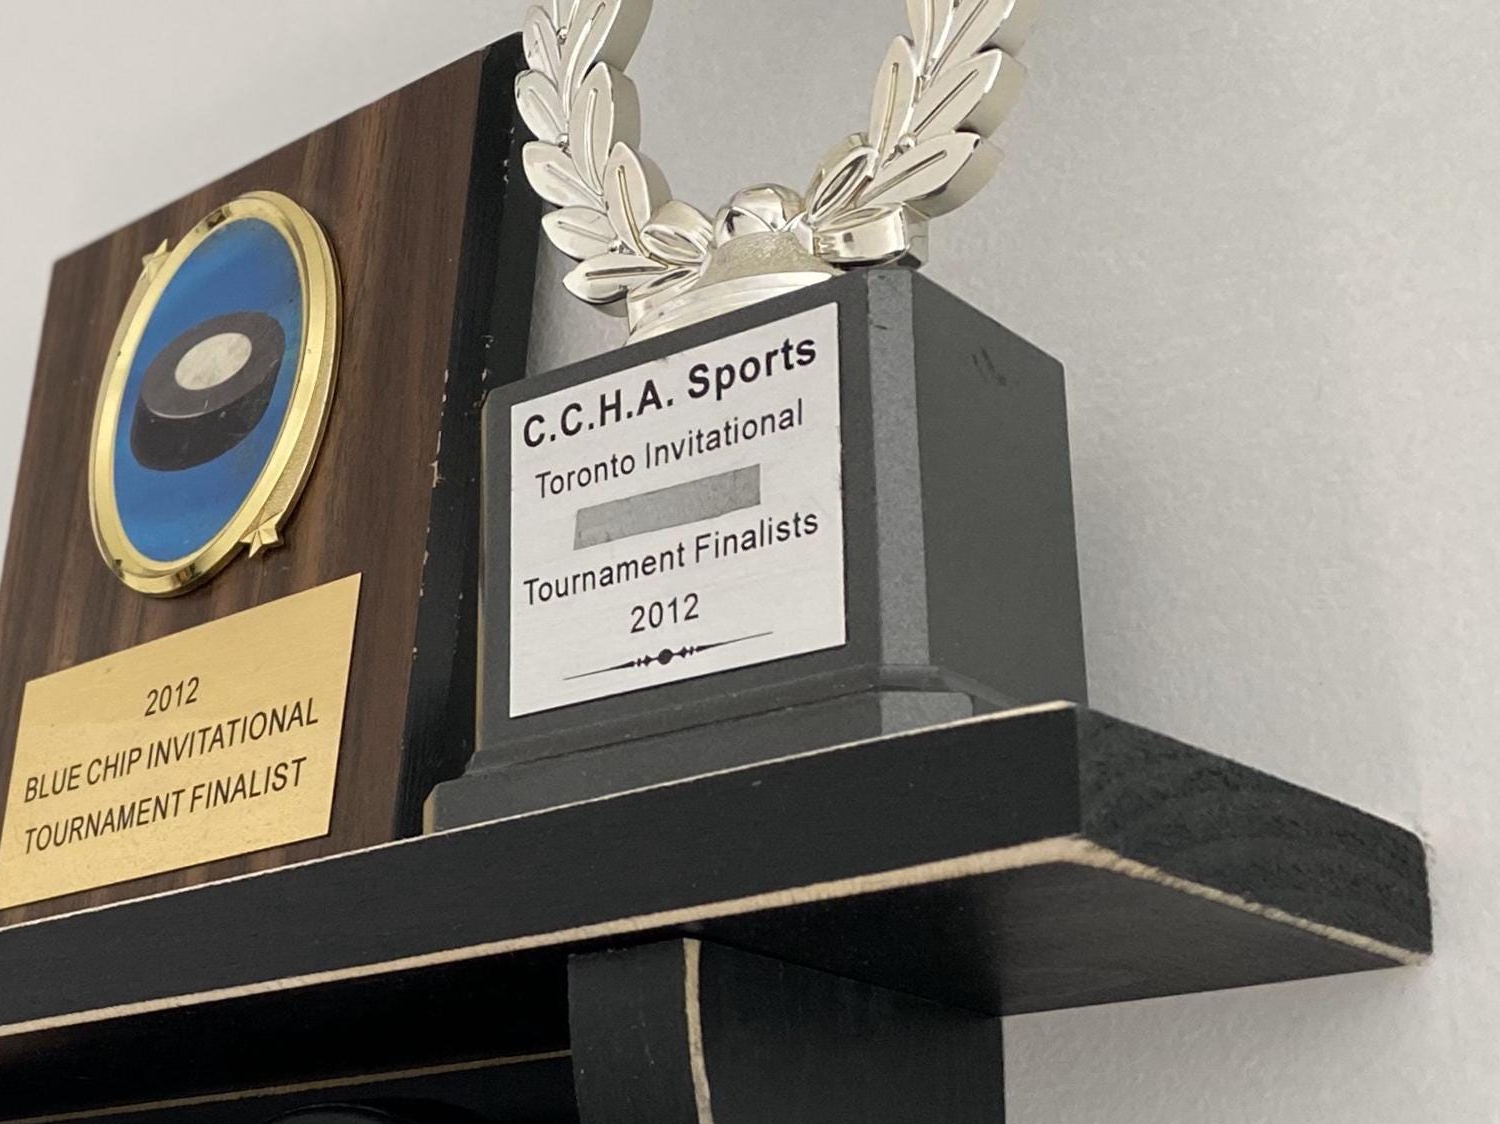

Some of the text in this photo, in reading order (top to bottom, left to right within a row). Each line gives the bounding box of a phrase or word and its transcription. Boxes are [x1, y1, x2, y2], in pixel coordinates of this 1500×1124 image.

[523, 337, 818, 448] C.C.H.A. Sports
[535, 398, 803, 499] Toronto Invitational
[523, 512, 819, 605] Tournament Finalists
[629, 592, 700, 633] 2012
[144, 676, 200, 716] 2012
[24, 697, 319, 803] BLUE CHIP INVITATIONAL
[25, 757, 307, 854] TOURNAMENT FINALIST
